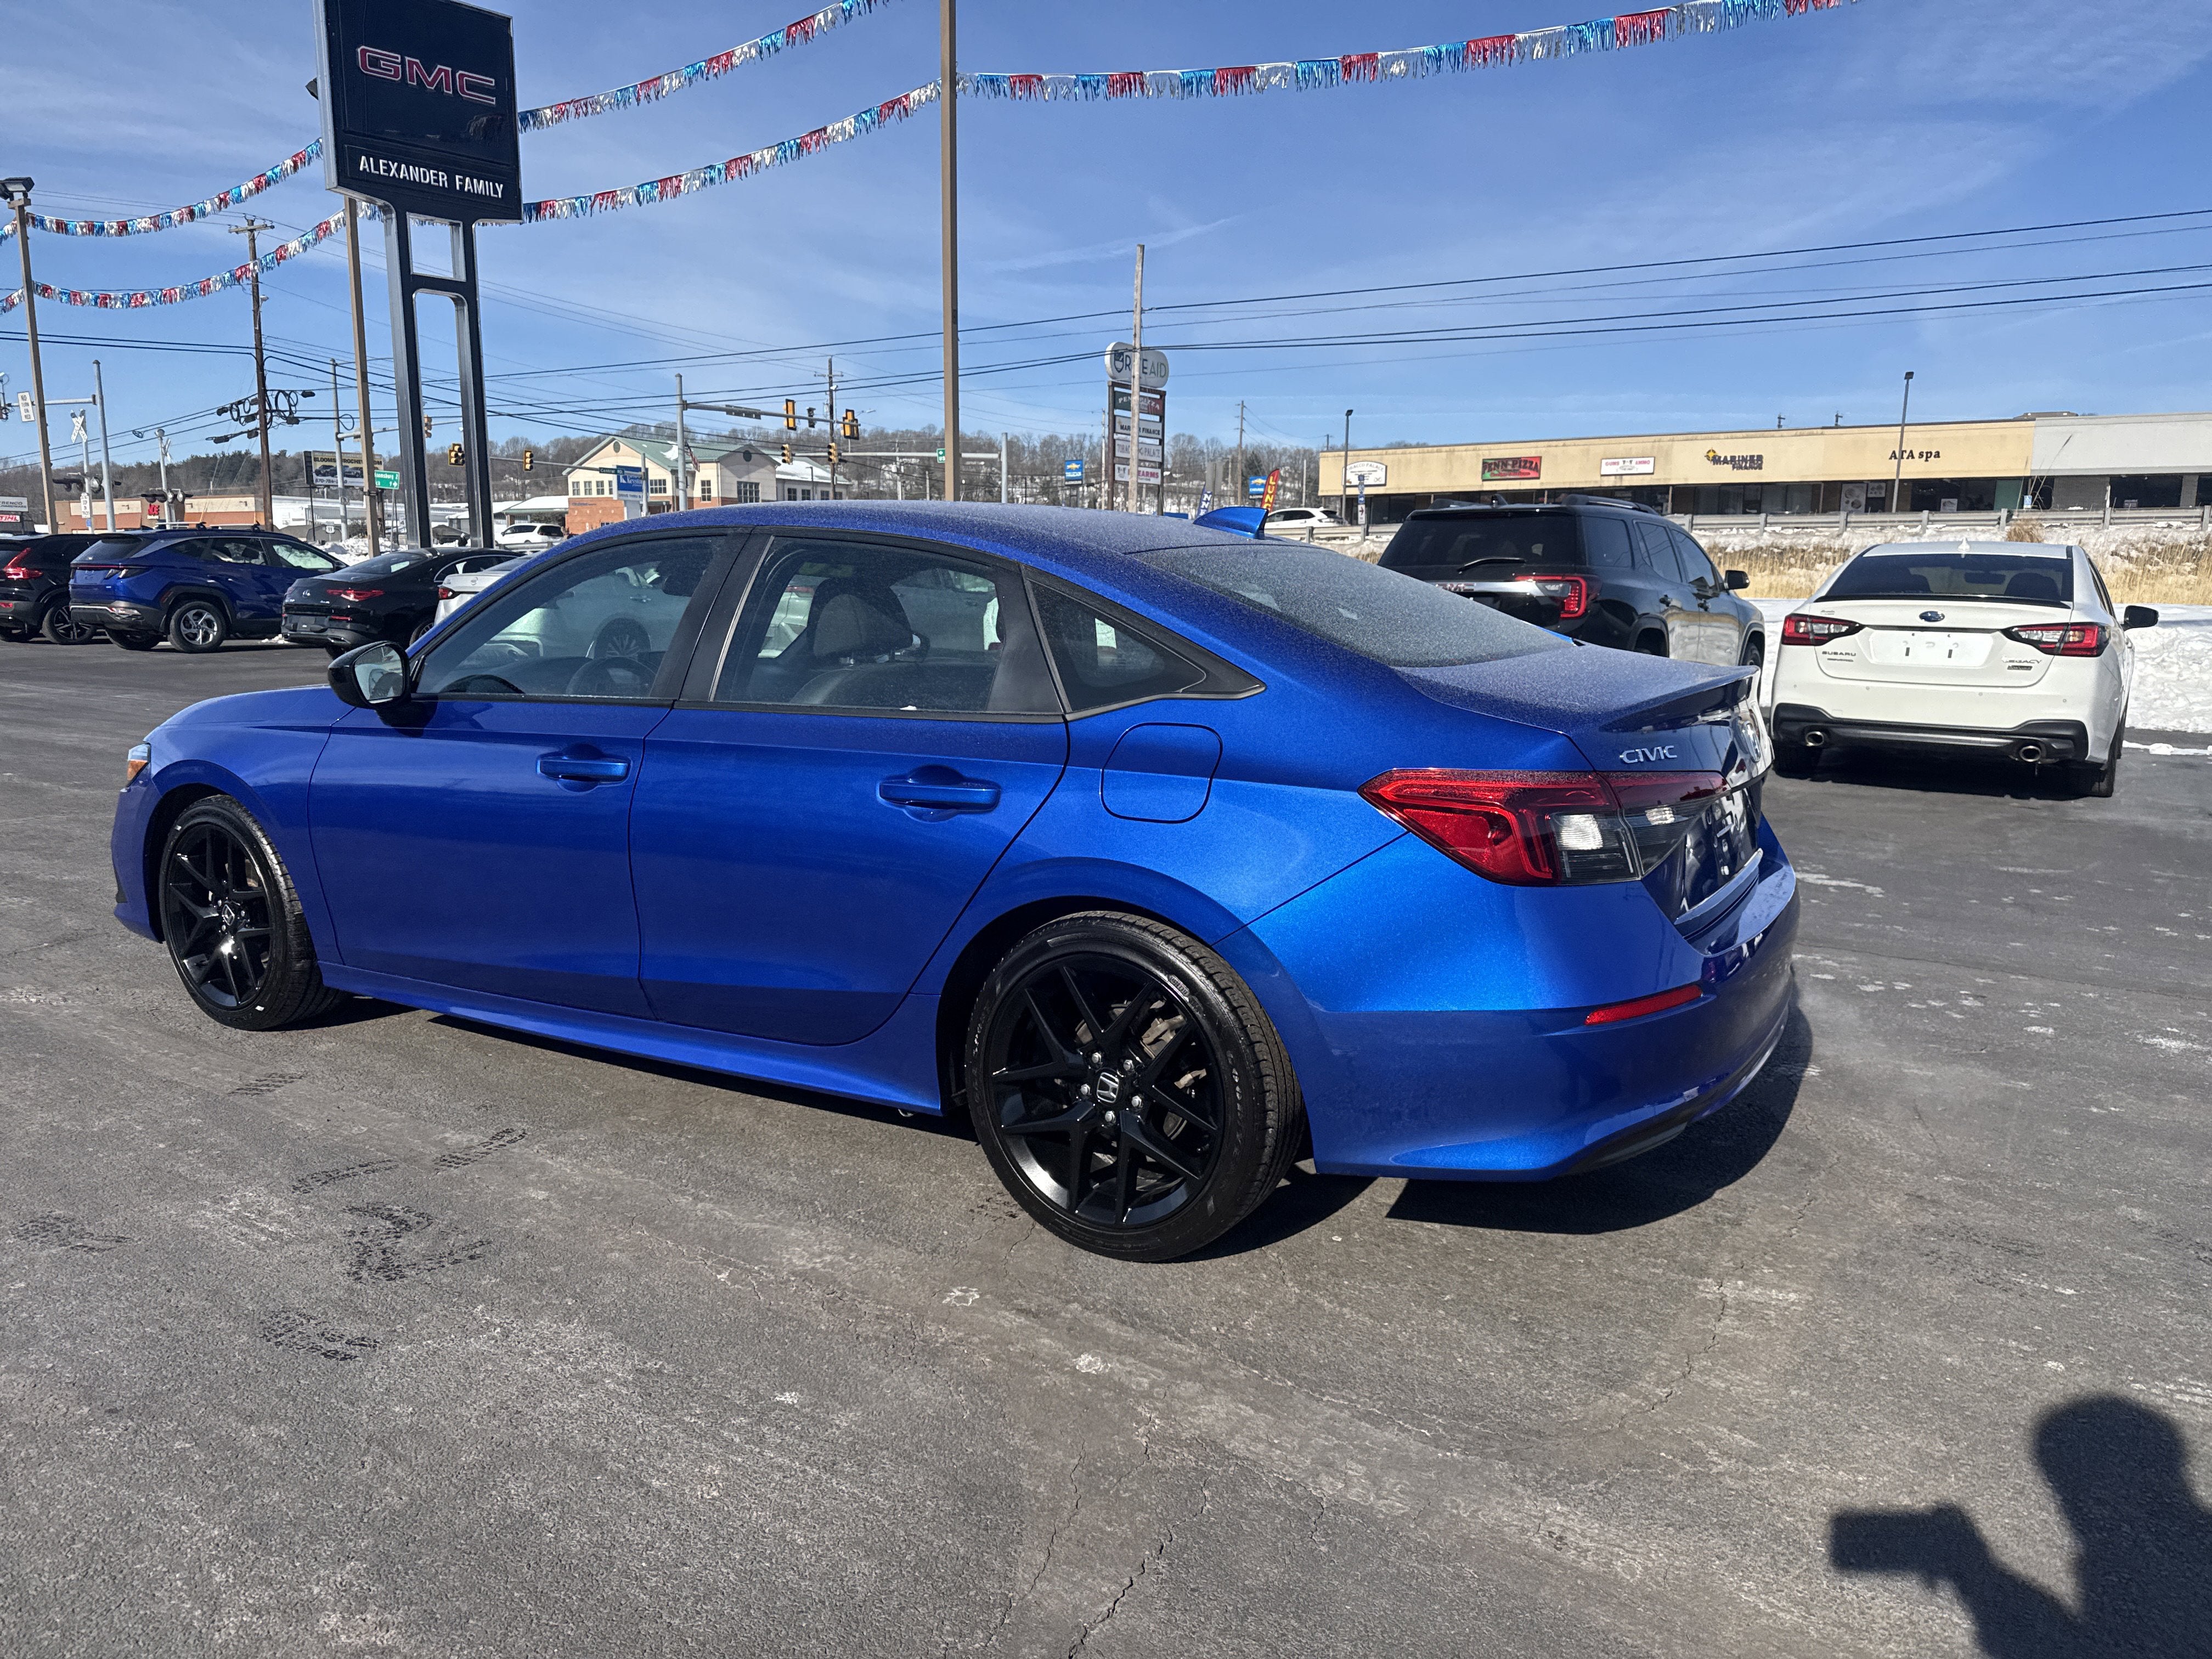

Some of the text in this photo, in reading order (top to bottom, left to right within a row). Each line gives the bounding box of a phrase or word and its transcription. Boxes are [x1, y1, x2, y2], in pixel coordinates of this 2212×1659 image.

[358, 46, 496, 105] GMC
[359, 155, 504, 199] ALEXANDER FAMILY
[1125, 354, 1166, 378] RE AID
[1512, 459, 1539, 472] PIZZA
[1712, 455, 1763, 465] MARINER
[1889, 449, 1940, 462] ATA spa
[1263, 476, 1276, 511] LUNC
[1619, 745, 1678, 764] CIVIC
